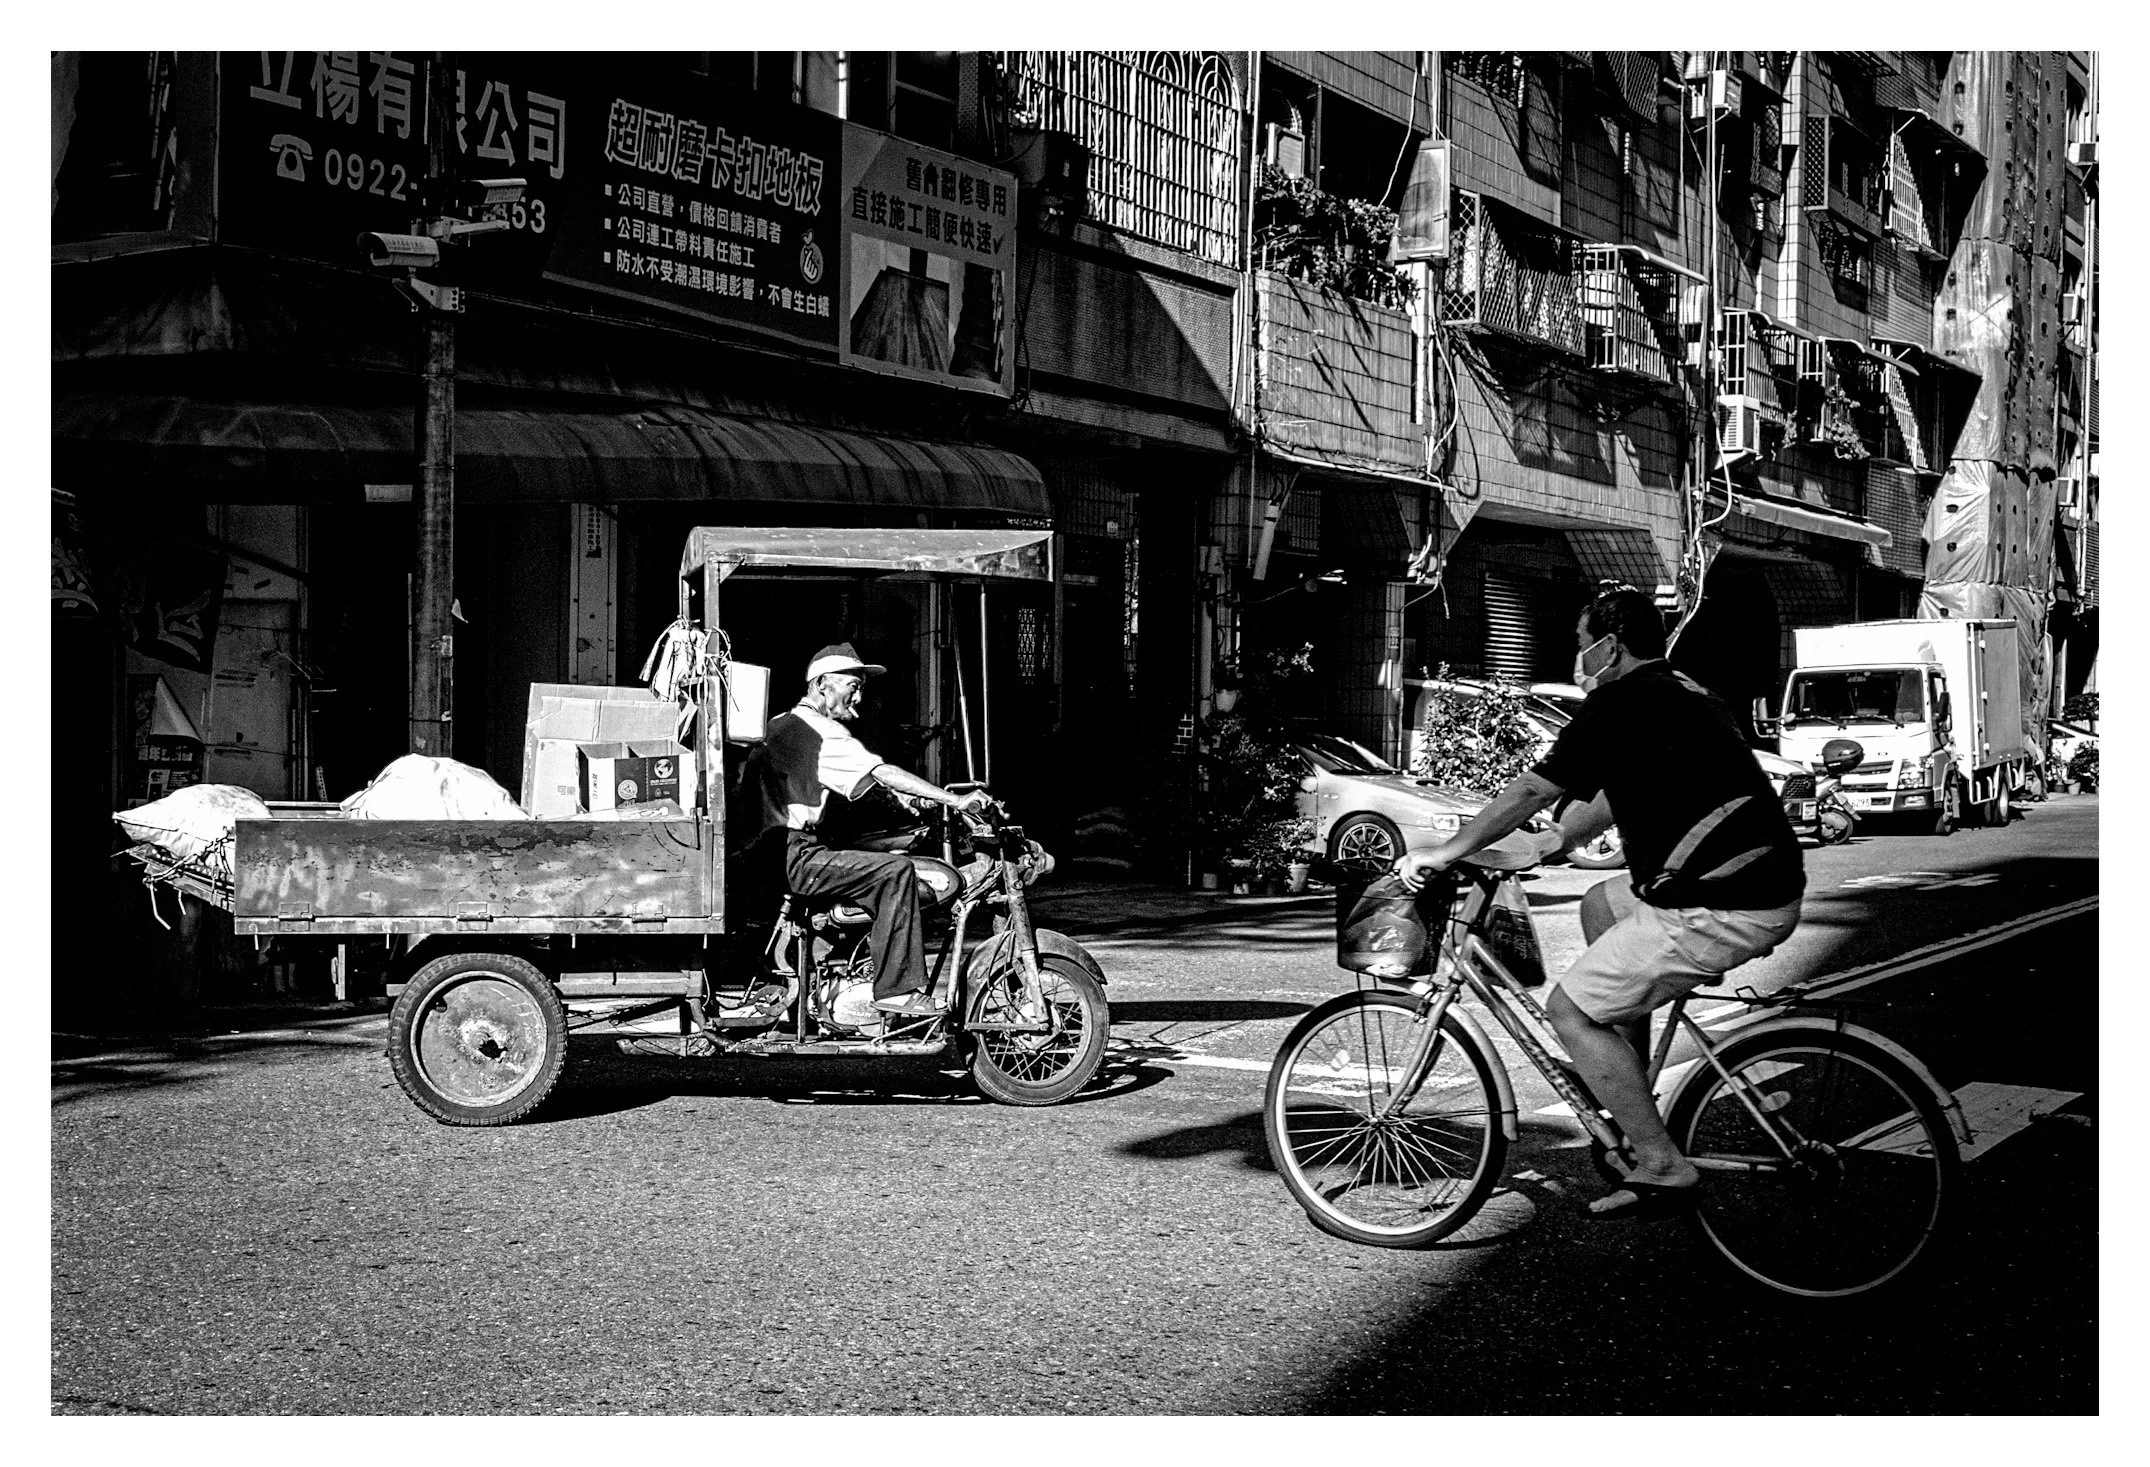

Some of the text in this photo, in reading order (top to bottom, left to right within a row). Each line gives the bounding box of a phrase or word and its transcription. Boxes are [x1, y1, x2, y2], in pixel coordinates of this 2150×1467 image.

[604, 98, 824, 216] 超耐磨卡扣地板
[617, 216, 755, 268] 公司連工帶料責任施工
[852, 186, 992, 254] 直接施工簡便快速
